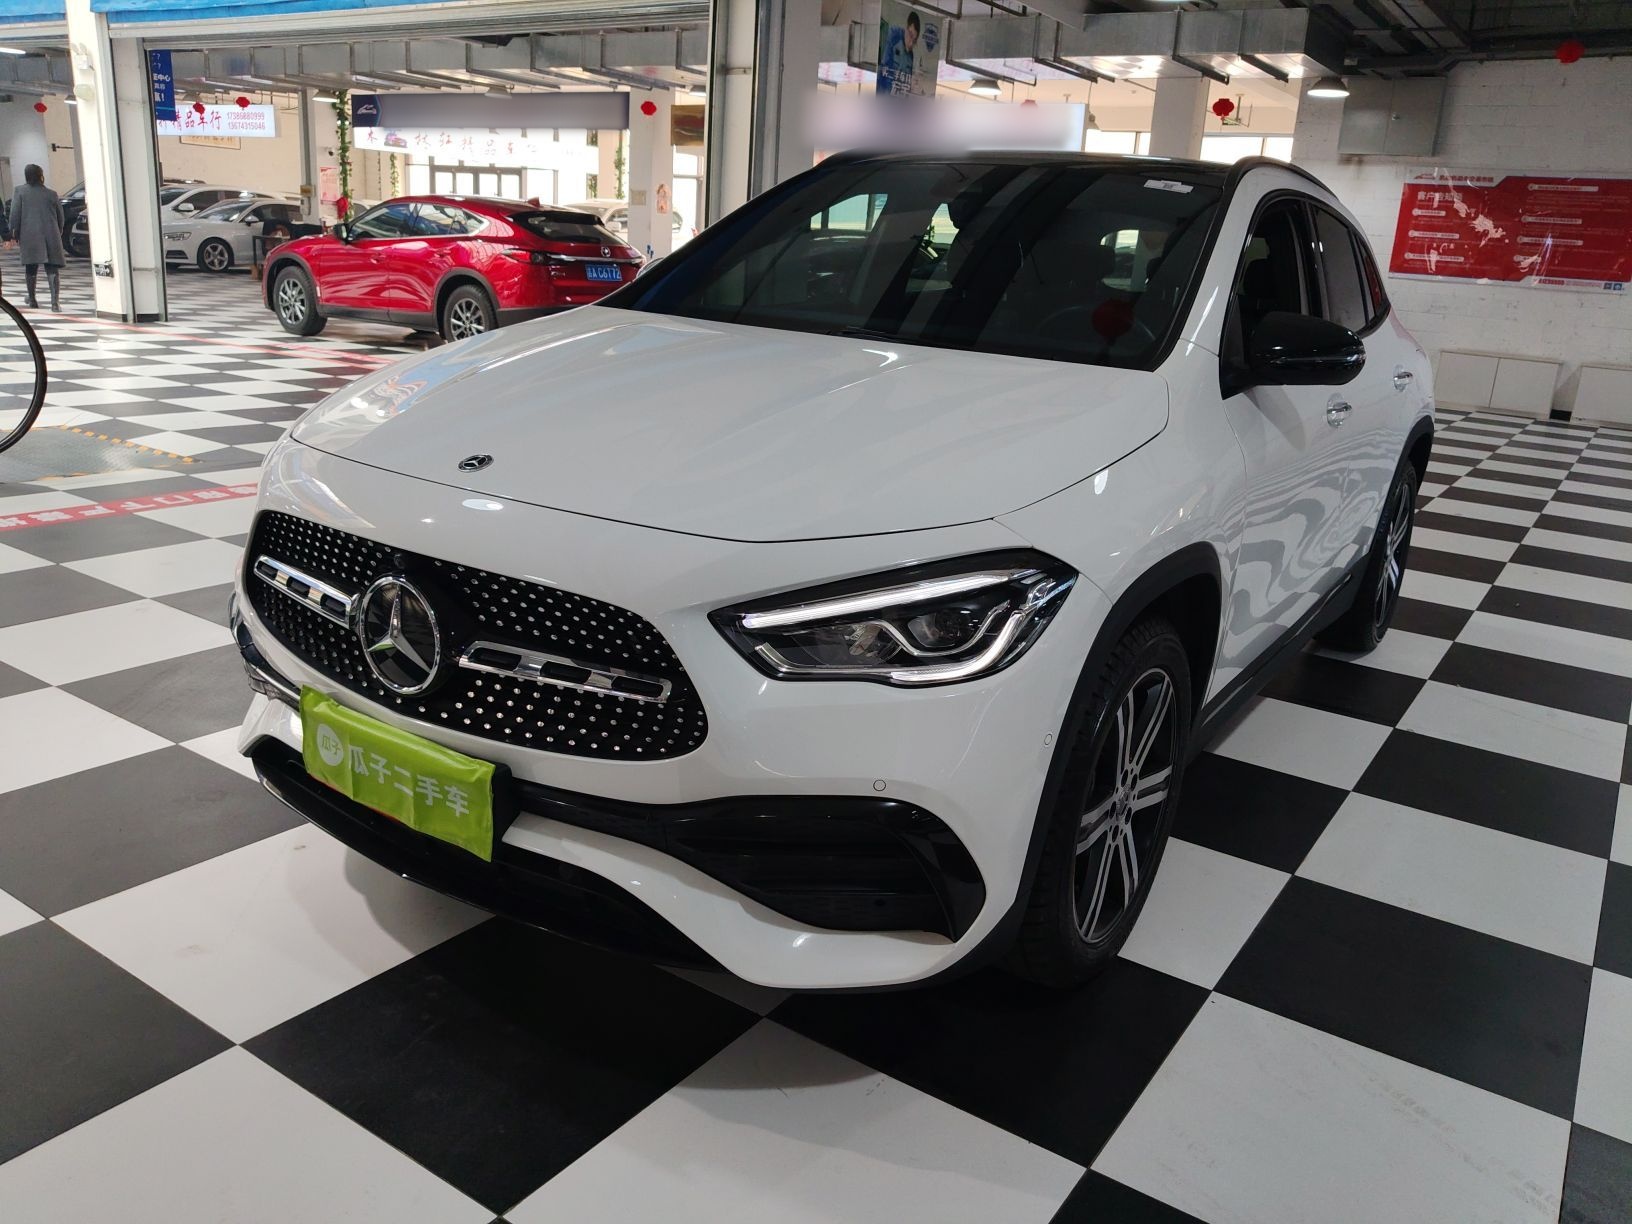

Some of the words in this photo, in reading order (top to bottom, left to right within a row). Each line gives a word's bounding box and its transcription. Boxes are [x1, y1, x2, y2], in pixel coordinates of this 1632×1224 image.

[321, 735, 345, 756] 瓜子
[349, 744, 470, 818] 瓜子二手车
